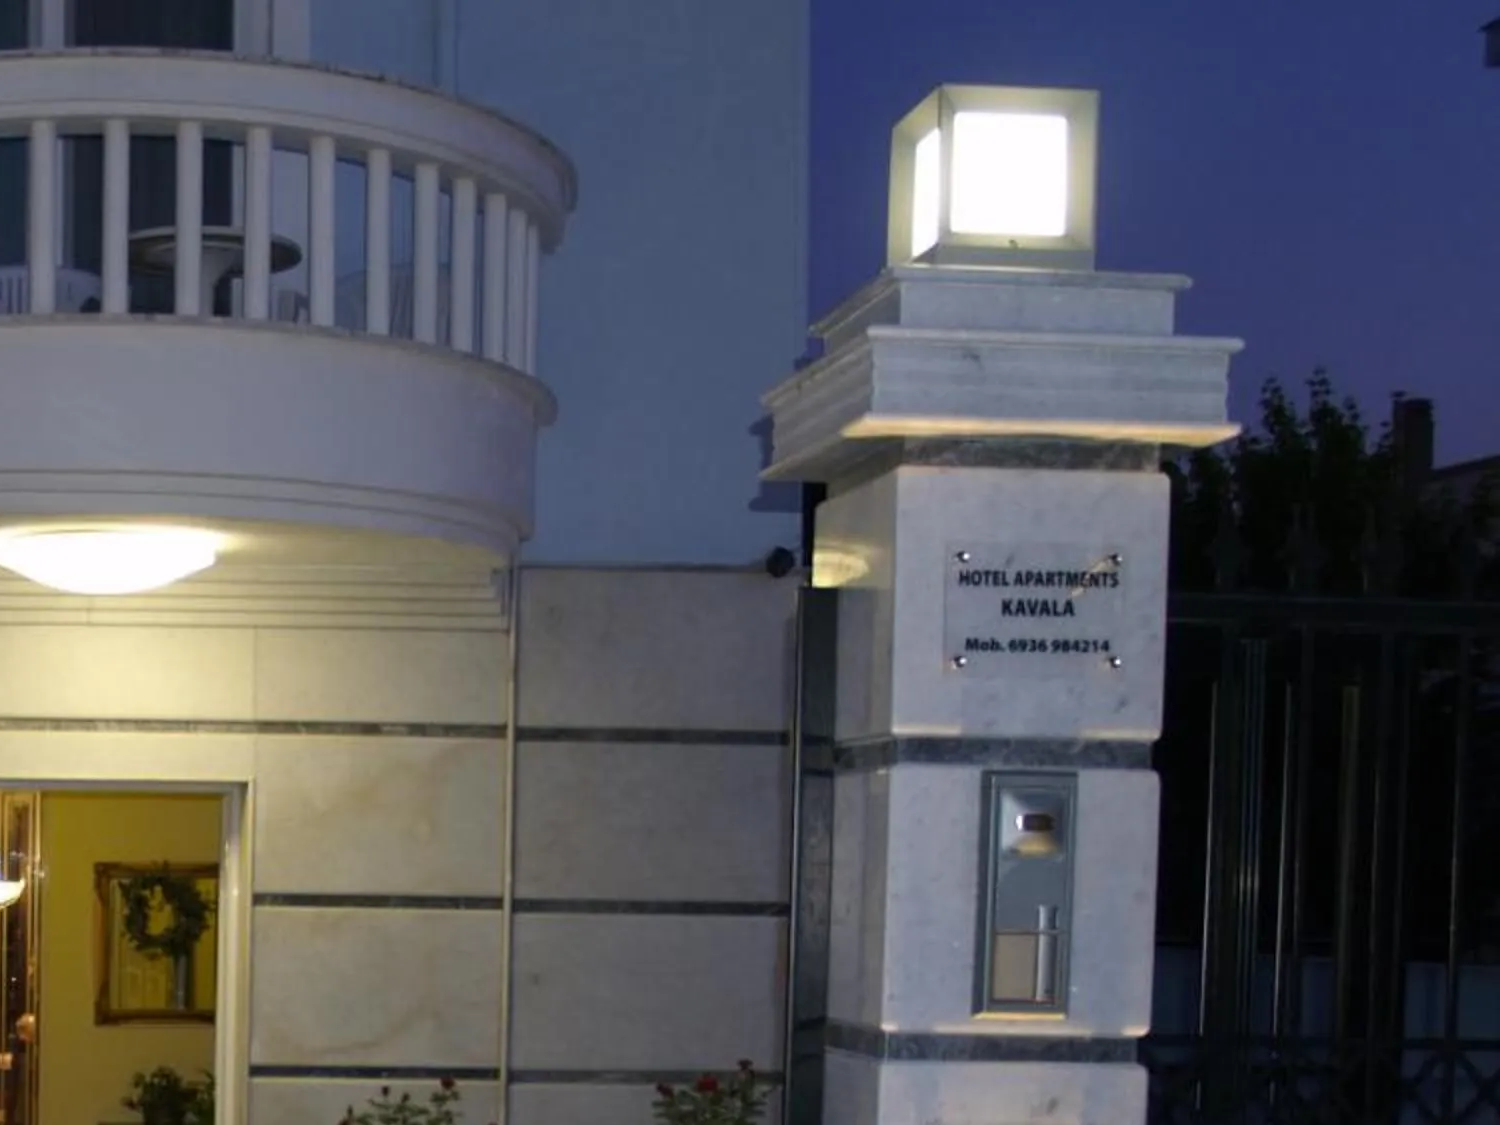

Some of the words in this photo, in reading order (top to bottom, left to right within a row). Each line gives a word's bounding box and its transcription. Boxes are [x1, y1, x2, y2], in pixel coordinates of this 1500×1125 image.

[958, 570, 1009, 587] HOTEL
[1014, 571, 1119, 588] APARTMENTS
[1001, 599, 1075, 617] KAVALA
[965, 638, 1004, 652] Mob.
[1008, 640, 1048, 653] 6936
[1051, 640, 1110, 653] 984214
